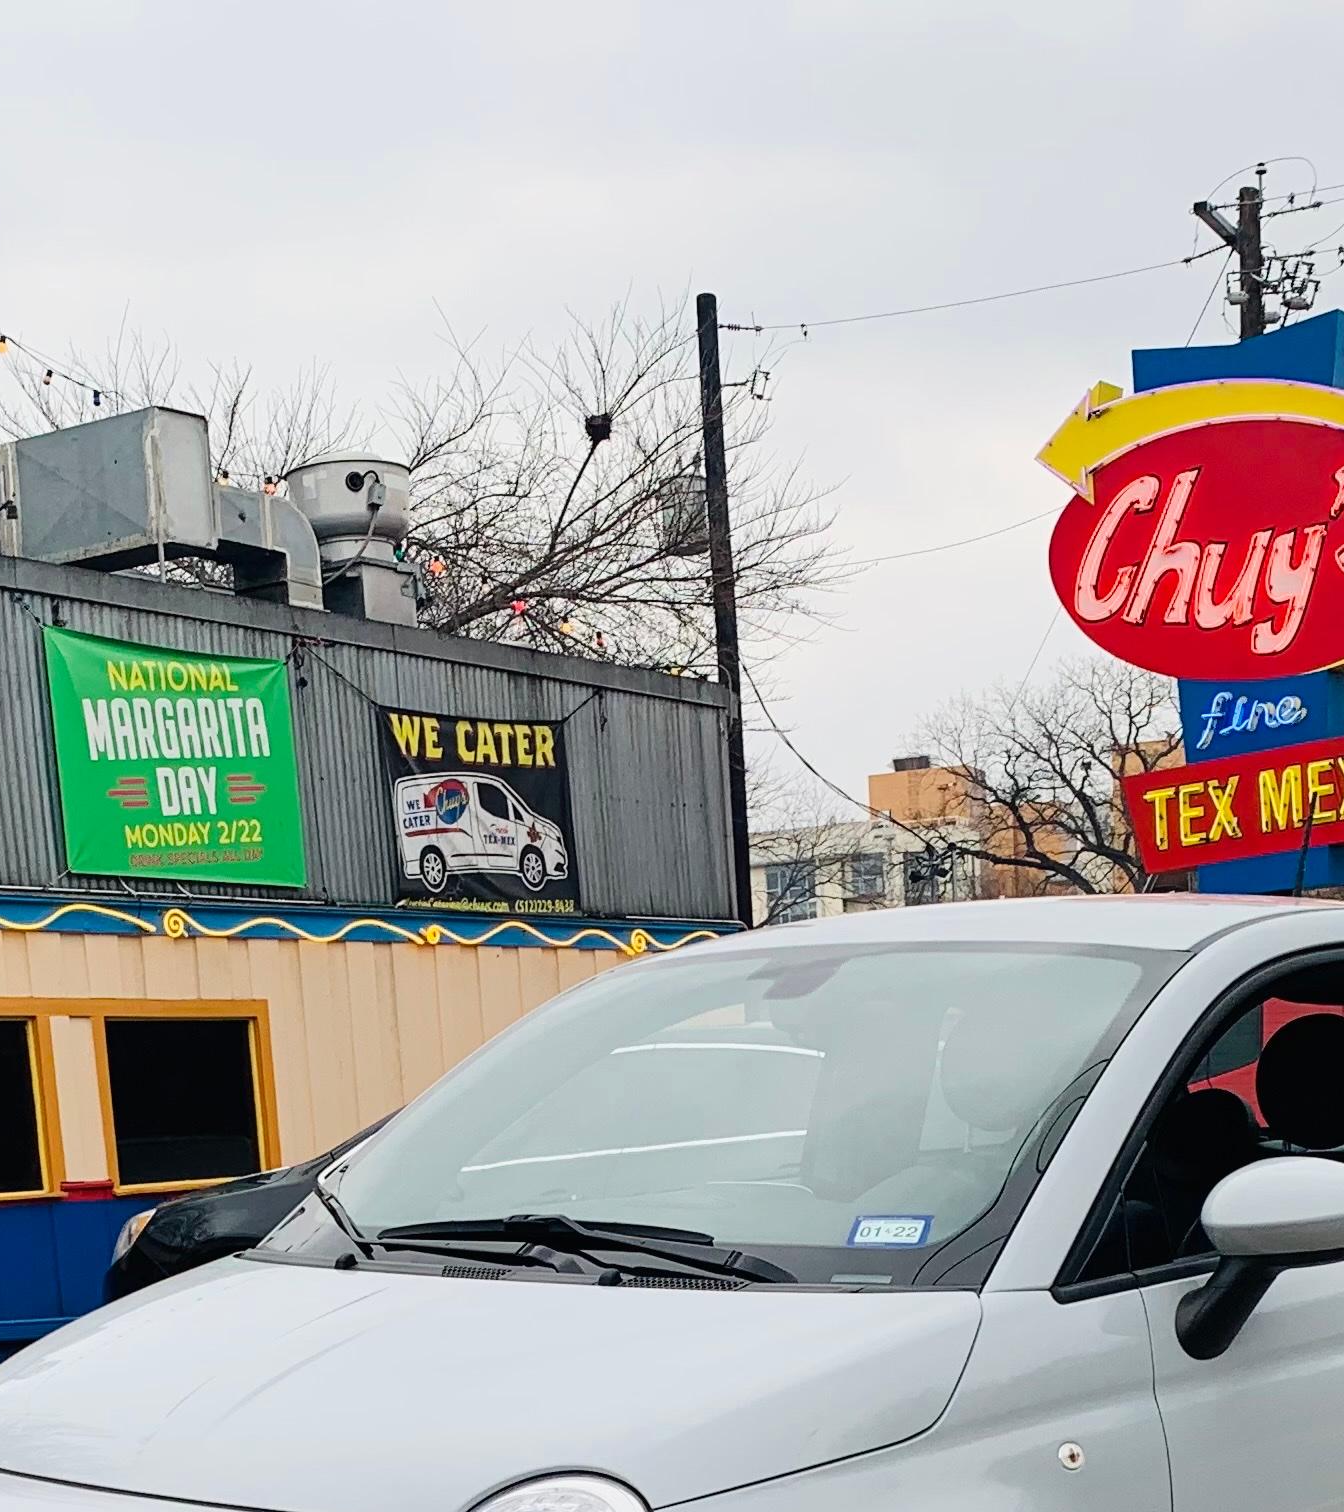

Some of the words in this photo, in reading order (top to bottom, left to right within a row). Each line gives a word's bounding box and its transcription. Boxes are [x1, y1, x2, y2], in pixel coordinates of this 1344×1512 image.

[106, 659, 240, 692] NATIONAL
[81, 697, 272, 761] MARGARITA
[388, 712, 444, 761] WE
[455, 719, 557, 768] CATER
[1196, 690, 1309, 751] fine
[155, 765, 218, 817] DAY
[405, 798, 422, 811] WE
[123, 820, 211, 849] MONDAY
[216, 818, 264, 845] 2/22
[402, 813, 431, 830] CATER
[1142, 774, 1243, 852] TEX
[859, 1226, 882, 1238] 01
[892, 1226, 919, 1238] 22
